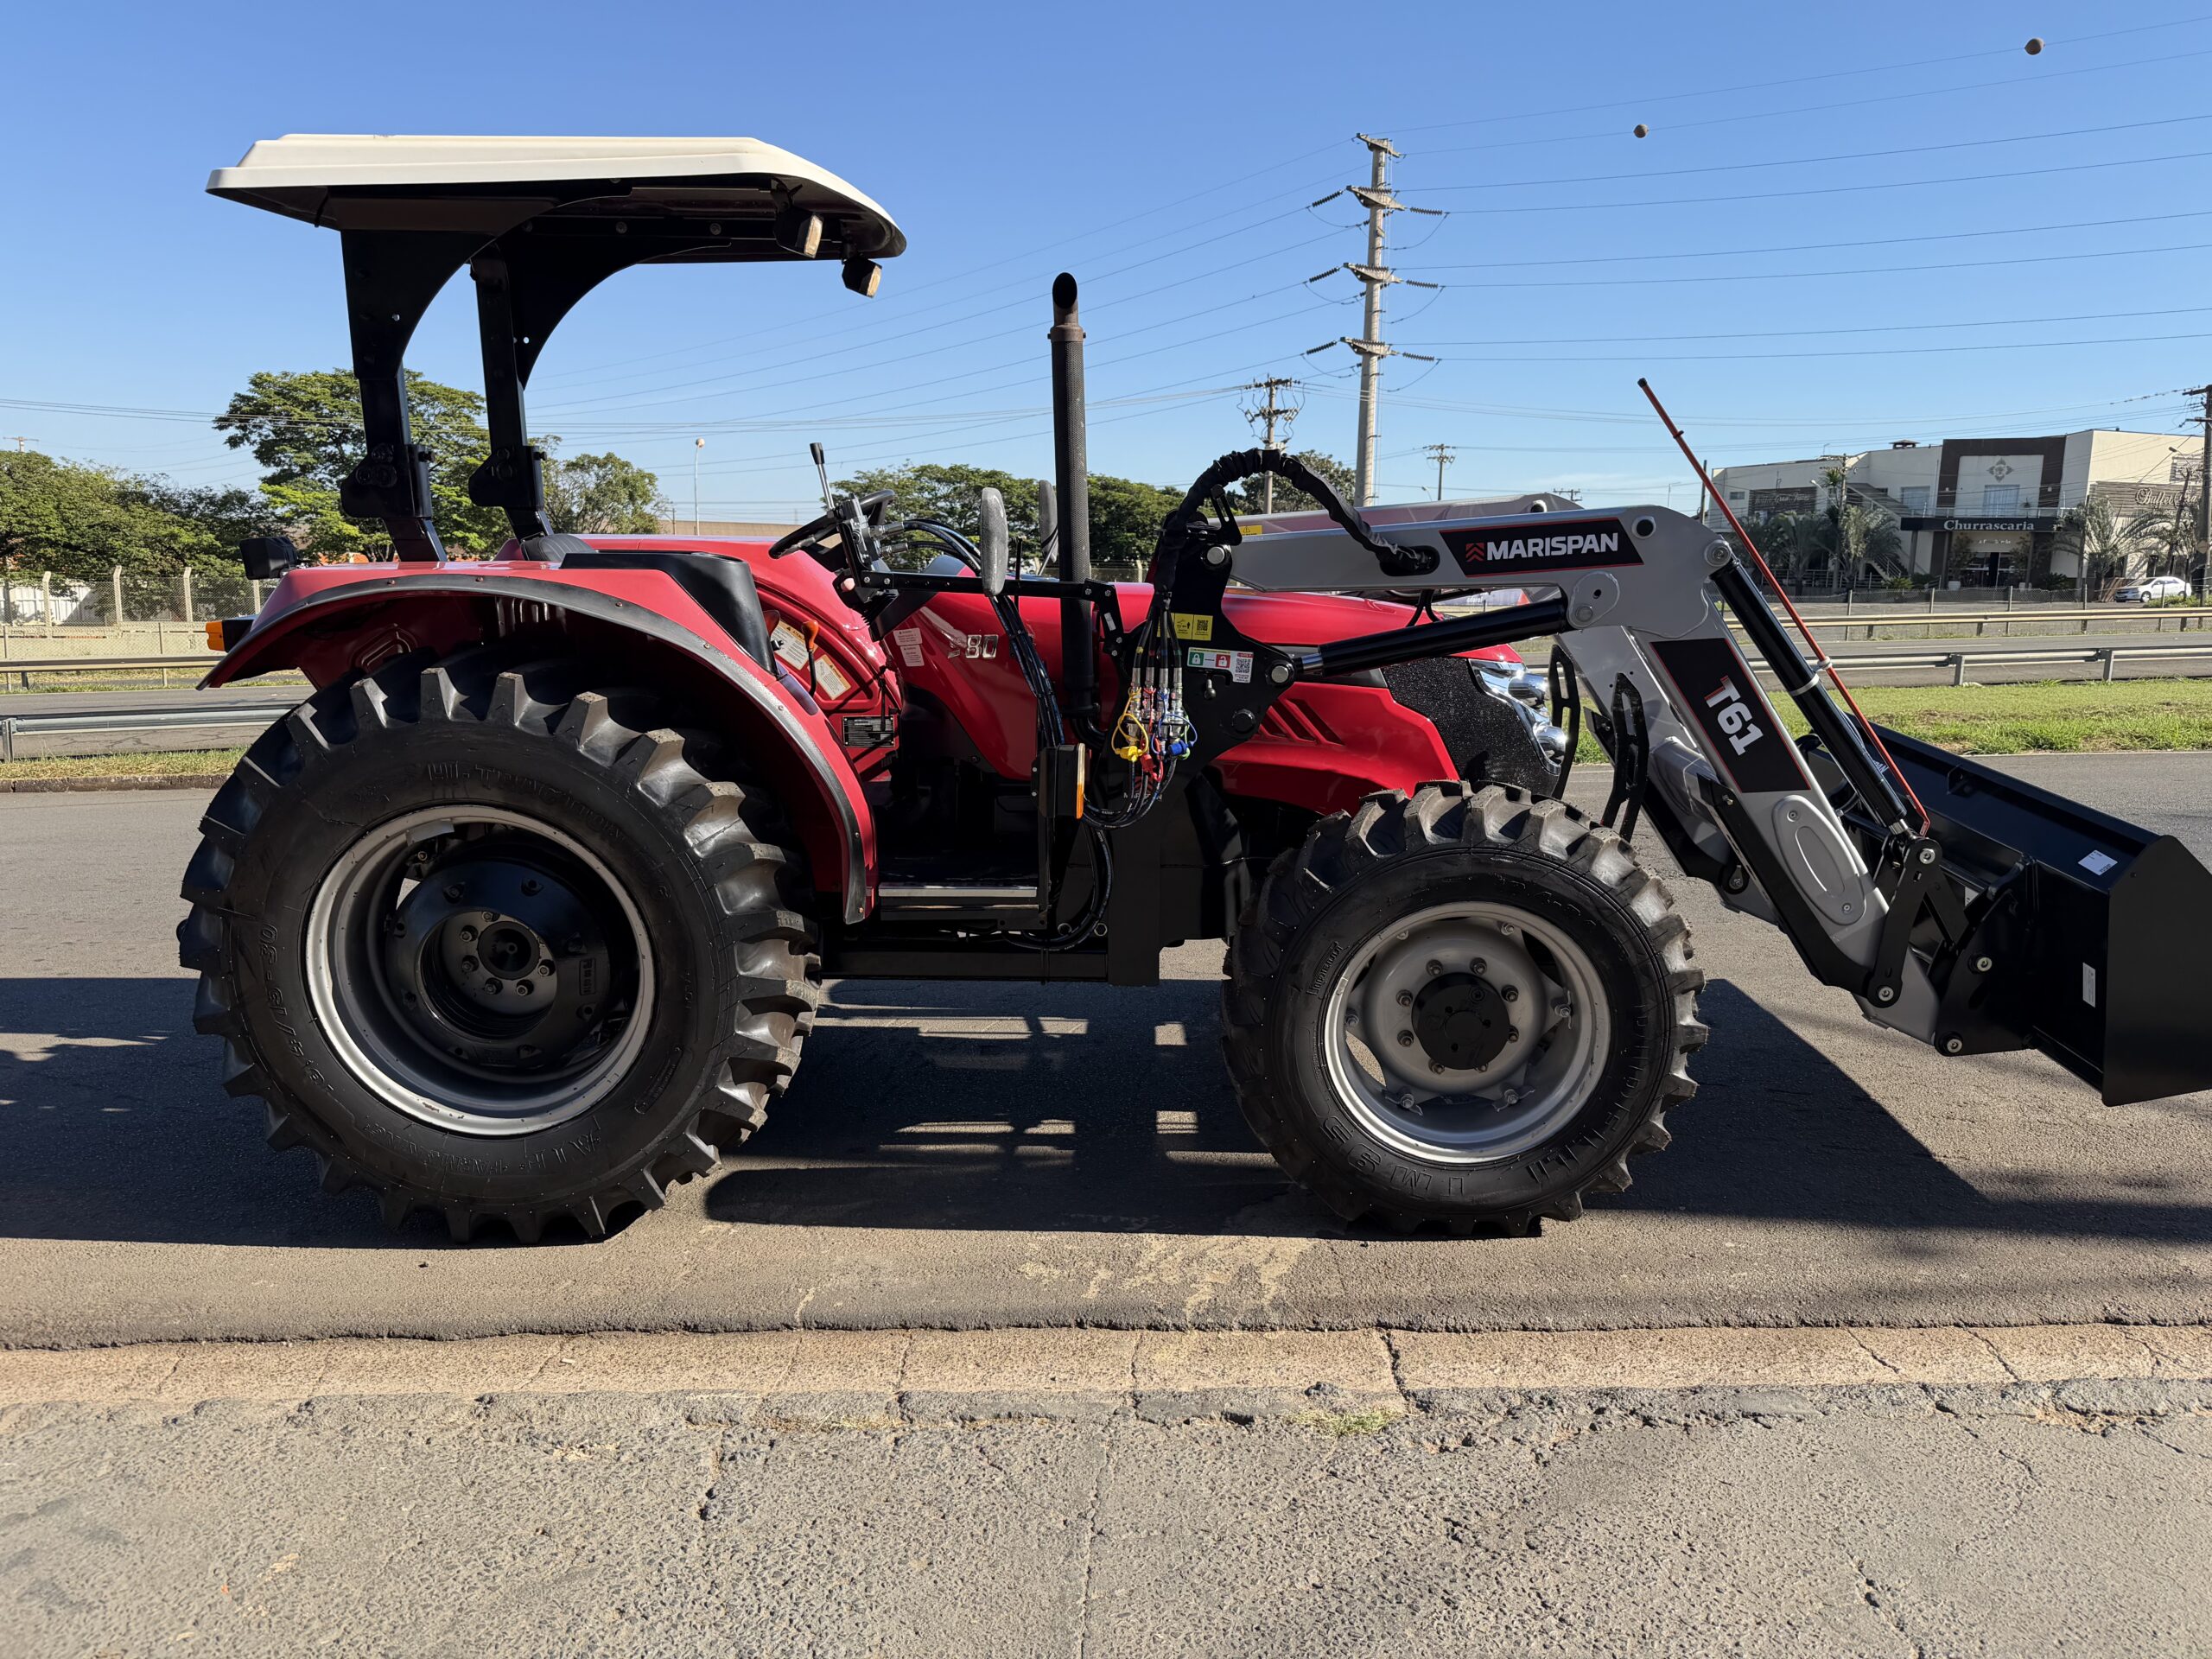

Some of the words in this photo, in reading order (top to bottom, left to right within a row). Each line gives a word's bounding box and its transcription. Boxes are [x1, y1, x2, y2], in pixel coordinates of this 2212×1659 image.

[2135, 487, 2175, 508] Buffet
[1943, 519, 2034, 531] Churrascaria
[1487, 532, 1618, 561] MARISPAN
[964, 634, 999, 658] 80
[1704, 675, 1764, 756] T61
